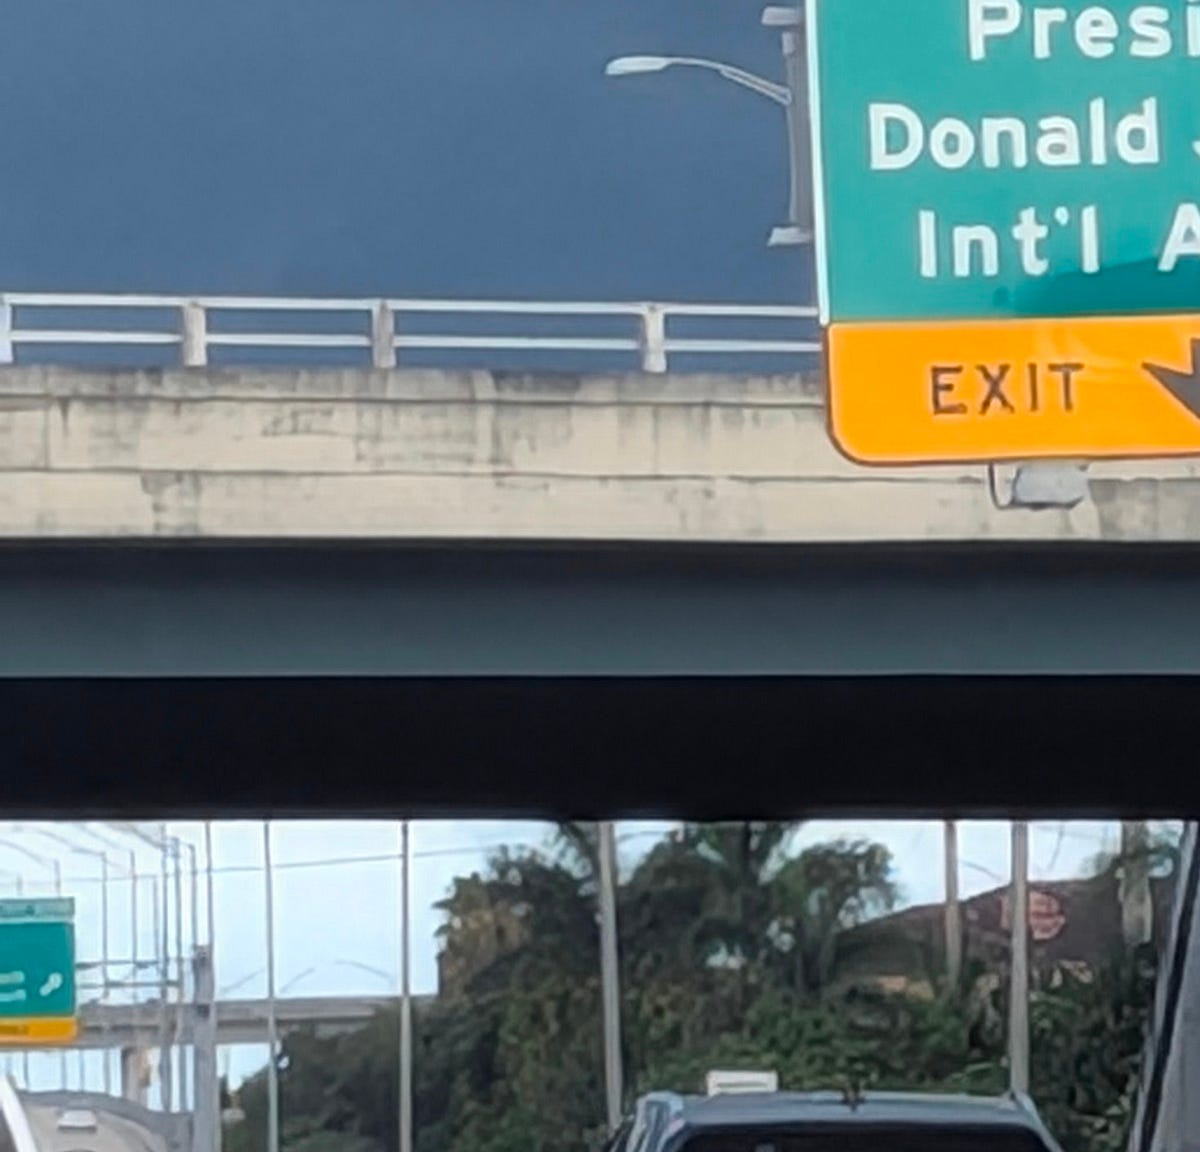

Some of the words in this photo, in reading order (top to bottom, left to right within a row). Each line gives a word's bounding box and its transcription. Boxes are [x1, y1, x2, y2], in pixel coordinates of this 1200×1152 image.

[869, 97, 1160, 170] Donald
[919, 206, 1099, 278] Int'l
[929, 363, 1084, 416] EXIT
